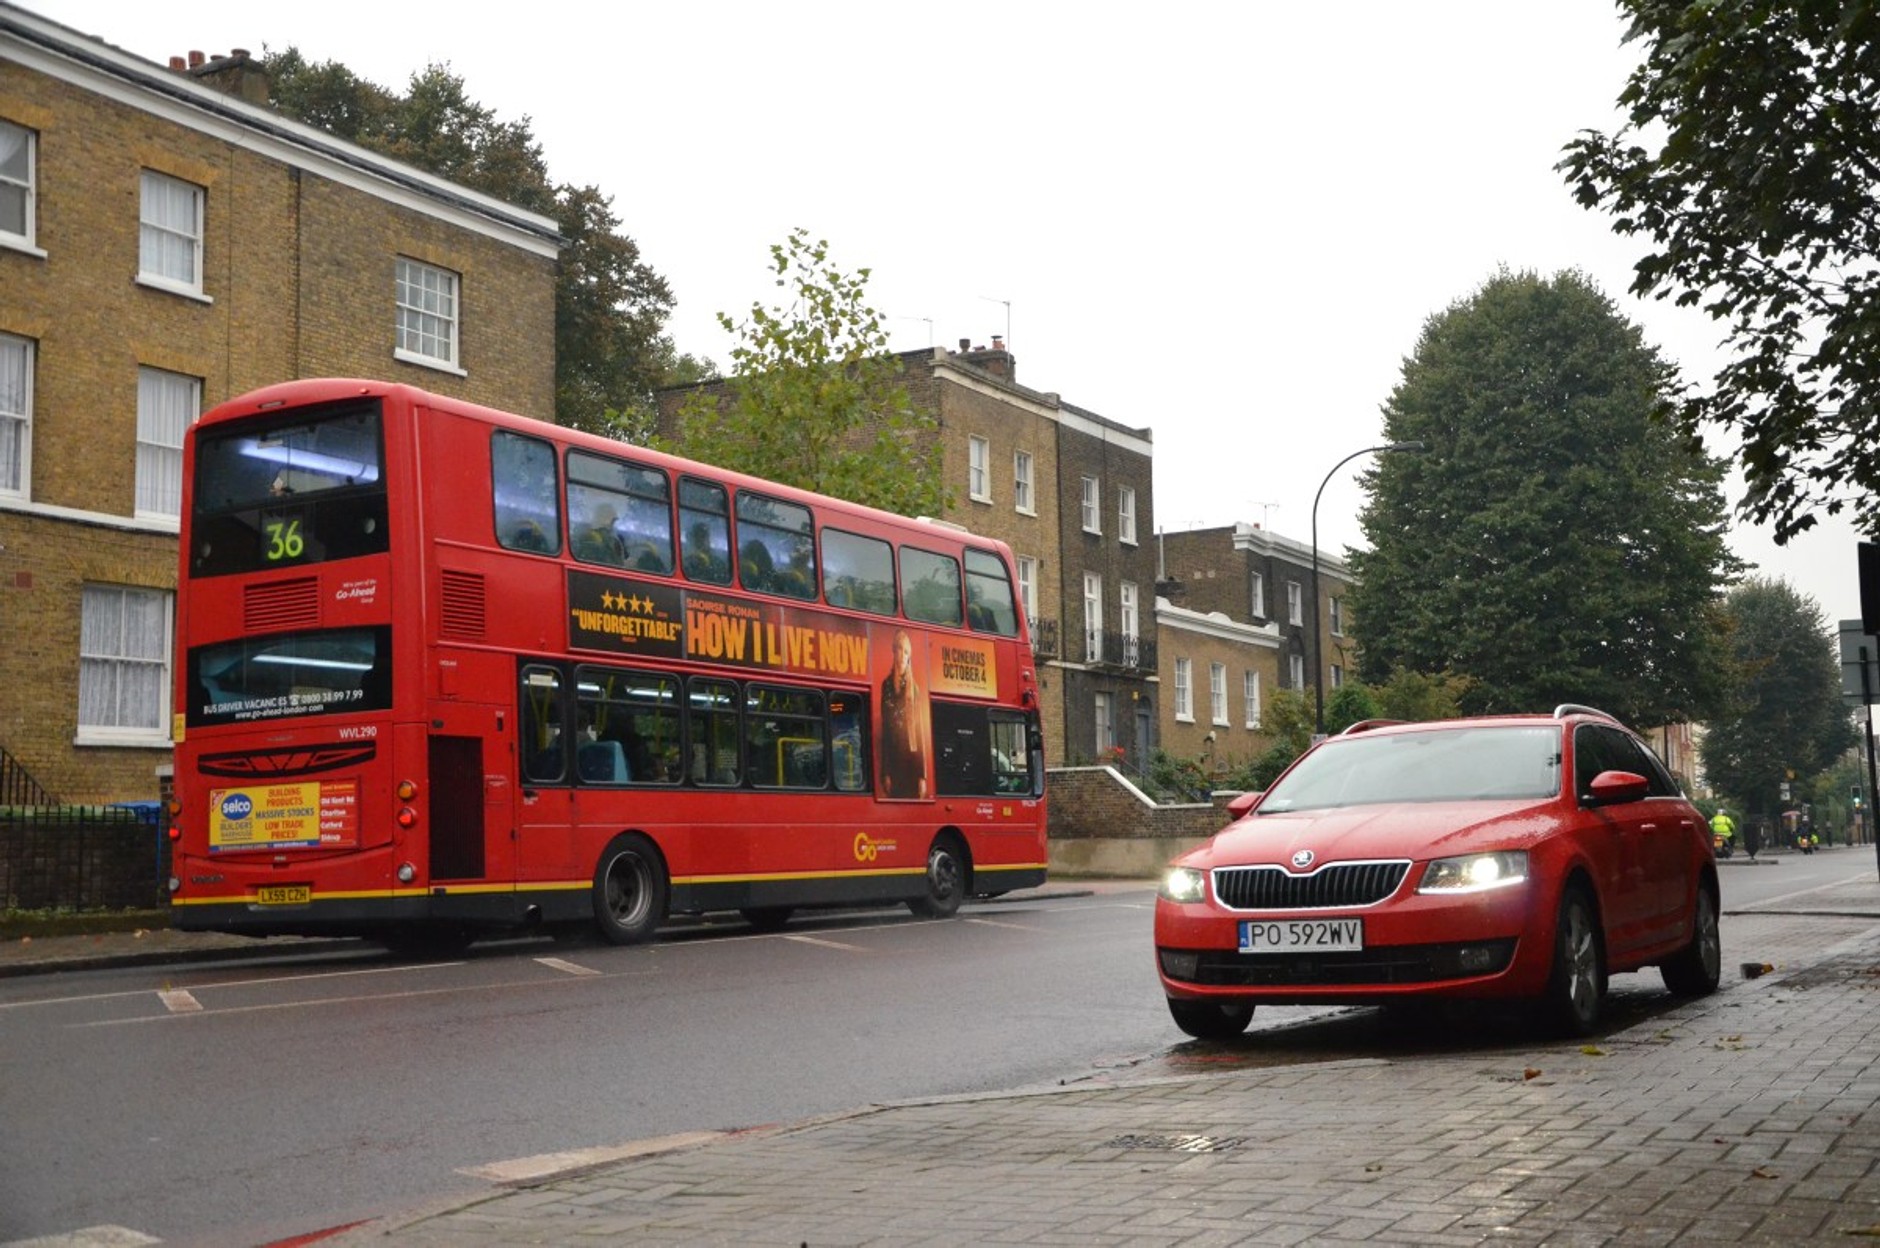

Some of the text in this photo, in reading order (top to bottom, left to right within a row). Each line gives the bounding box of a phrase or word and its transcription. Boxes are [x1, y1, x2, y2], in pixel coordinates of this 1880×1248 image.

[266, 520, 304, 560] 36
[335, 585, 377, 600] Go-Ahead
[686, 609, 869, 676] HOW I LIVE NOW
[941, 646, 986, 667] IN CINEMAS
[943, 662, 987, 684] OCTOBER 4
[339, 726, 378, 739] WVL290
[222, 799, 251, 814] selco
[264, 822, 280, 831] LOW
[1251, 921, 1358, 947] PO 592WV
